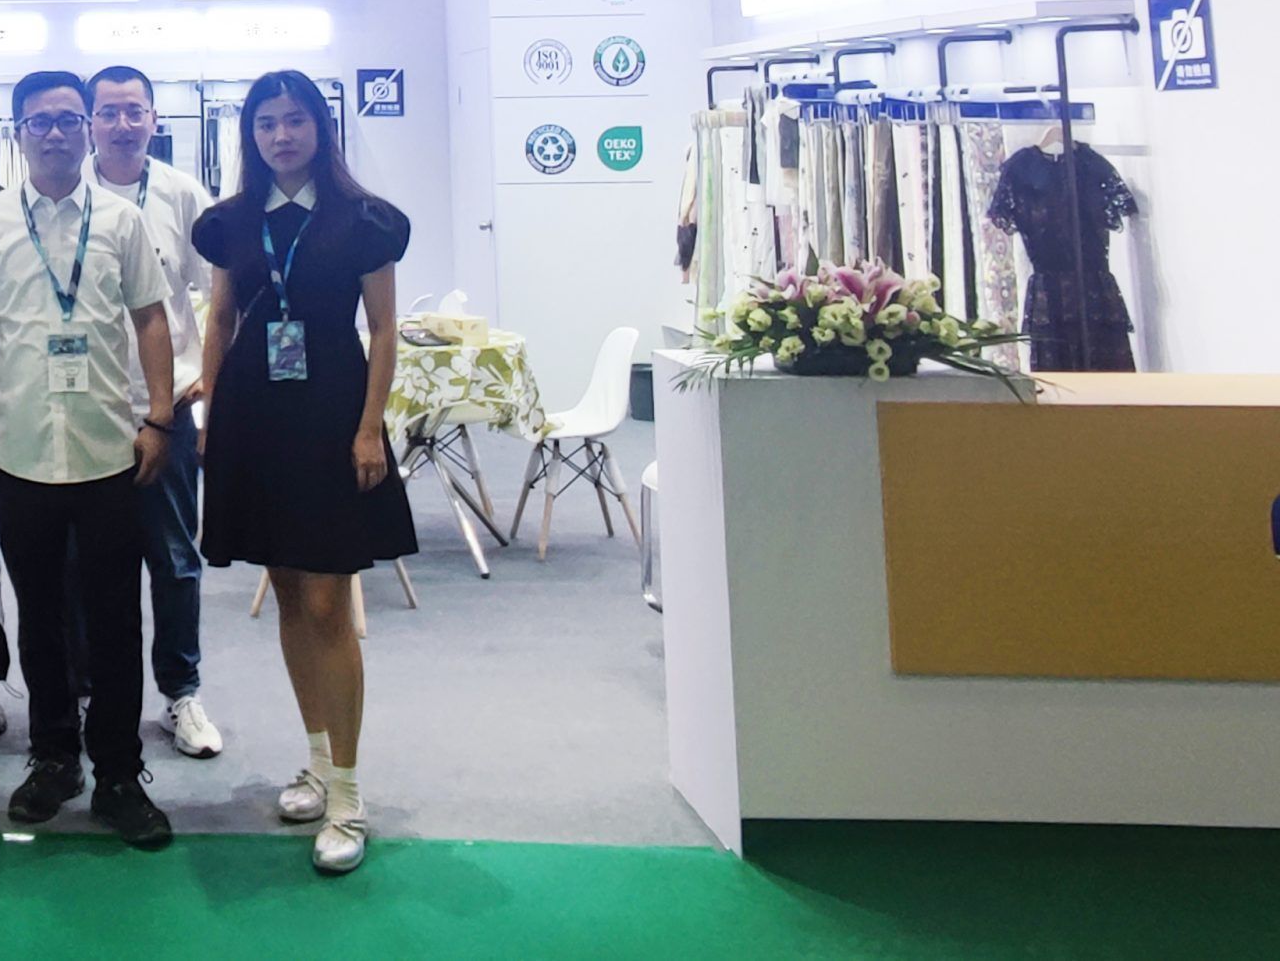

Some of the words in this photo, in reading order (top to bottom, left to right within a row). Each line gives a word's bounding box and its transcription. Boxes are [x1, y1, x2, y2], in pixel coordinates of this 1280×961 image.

[536, 50, 559, 61] ISO
[535, 60, 560, 71] 9001
[603, 138, 637, 150] OEKO
